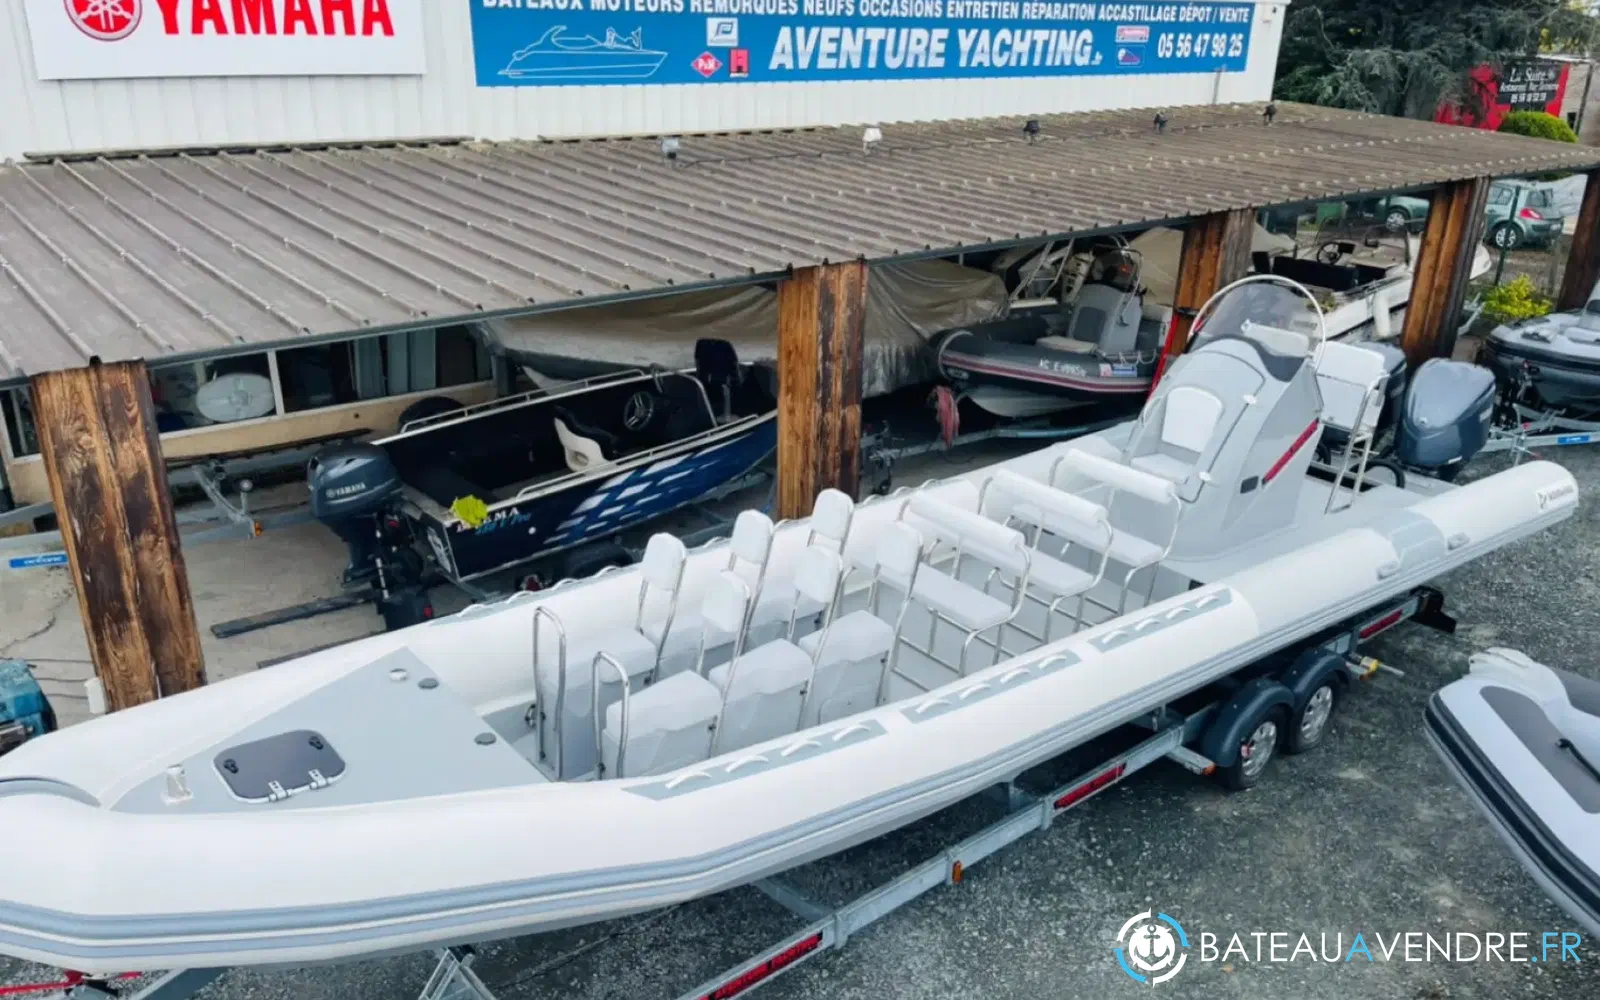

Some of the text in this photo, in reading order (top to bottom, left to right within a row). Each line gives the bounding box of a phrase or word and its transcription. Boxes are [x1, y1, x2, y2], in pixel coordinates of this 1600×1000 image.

[152, 0, 395, 36] YAMAHA
[590, 0, 684, 13] MOTEURS
[689, 0, 798, 15] REMORQUES
[803, 0, 855, 17] NEUFS
[859, 0, 943, 18] OCCASIONS
[946, 1, 1019, 19] ENTRETIEN
[1021, 0, 1096, 21] RÉPARATION
[1098, 3, 1176, 22] ACCASTILLAGE
[1218, 7, 1250, 23] VENTE
[768, 26, 949, 70] AVENTURE
[1157, 33, 1174, 58] 05
[1176, 33, 1192, 58] 56
[1193, 34, 1209, 58] 47
[1211, 33, 1227, 58] 98
[1227, 34, 1244, 57] 25
[336, 481, 366, 497] YAMAHA
